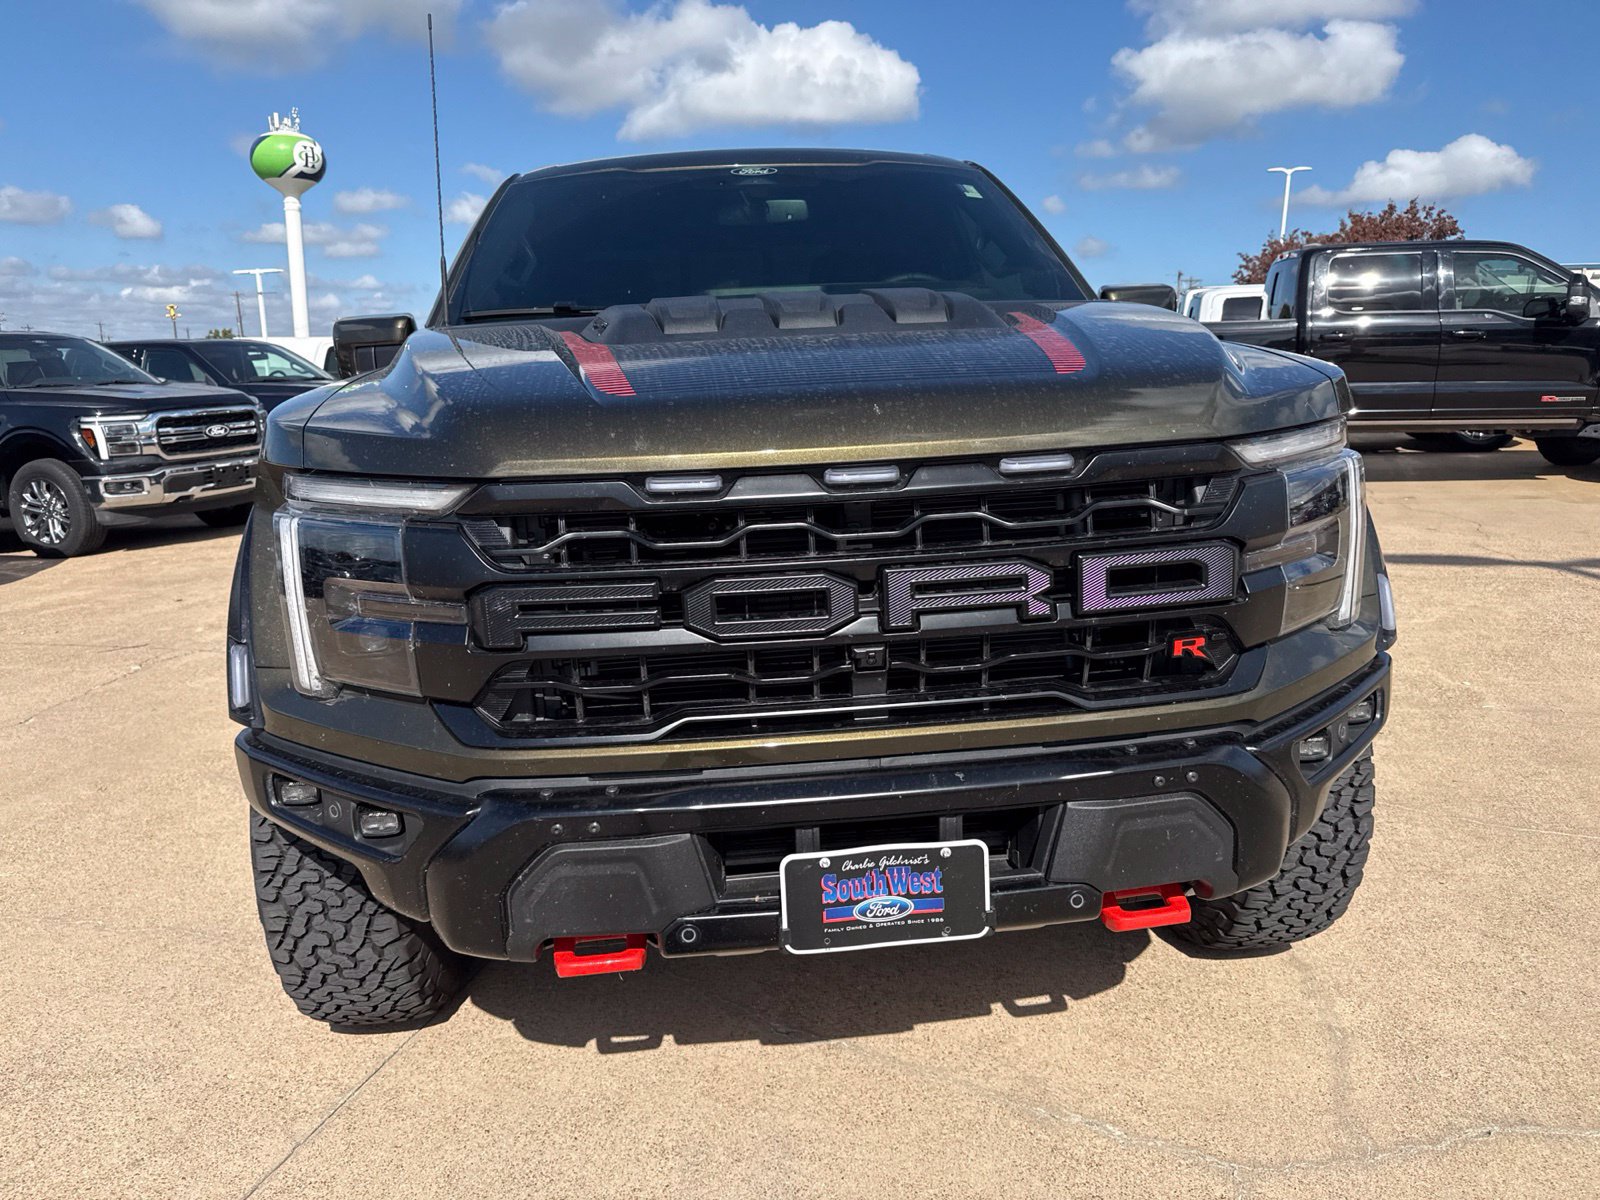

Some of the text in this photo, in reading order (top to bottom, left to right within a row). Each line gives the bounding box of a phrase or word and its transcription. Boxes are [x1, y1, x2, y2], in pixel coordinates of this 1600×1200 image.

[473, 541, 1240, 650] FORD
[1173, 636, 1210, 660] R
[842, 854, 930, 872] Charlie Gilchrist's
[866, 900, 900, 918] Ford
